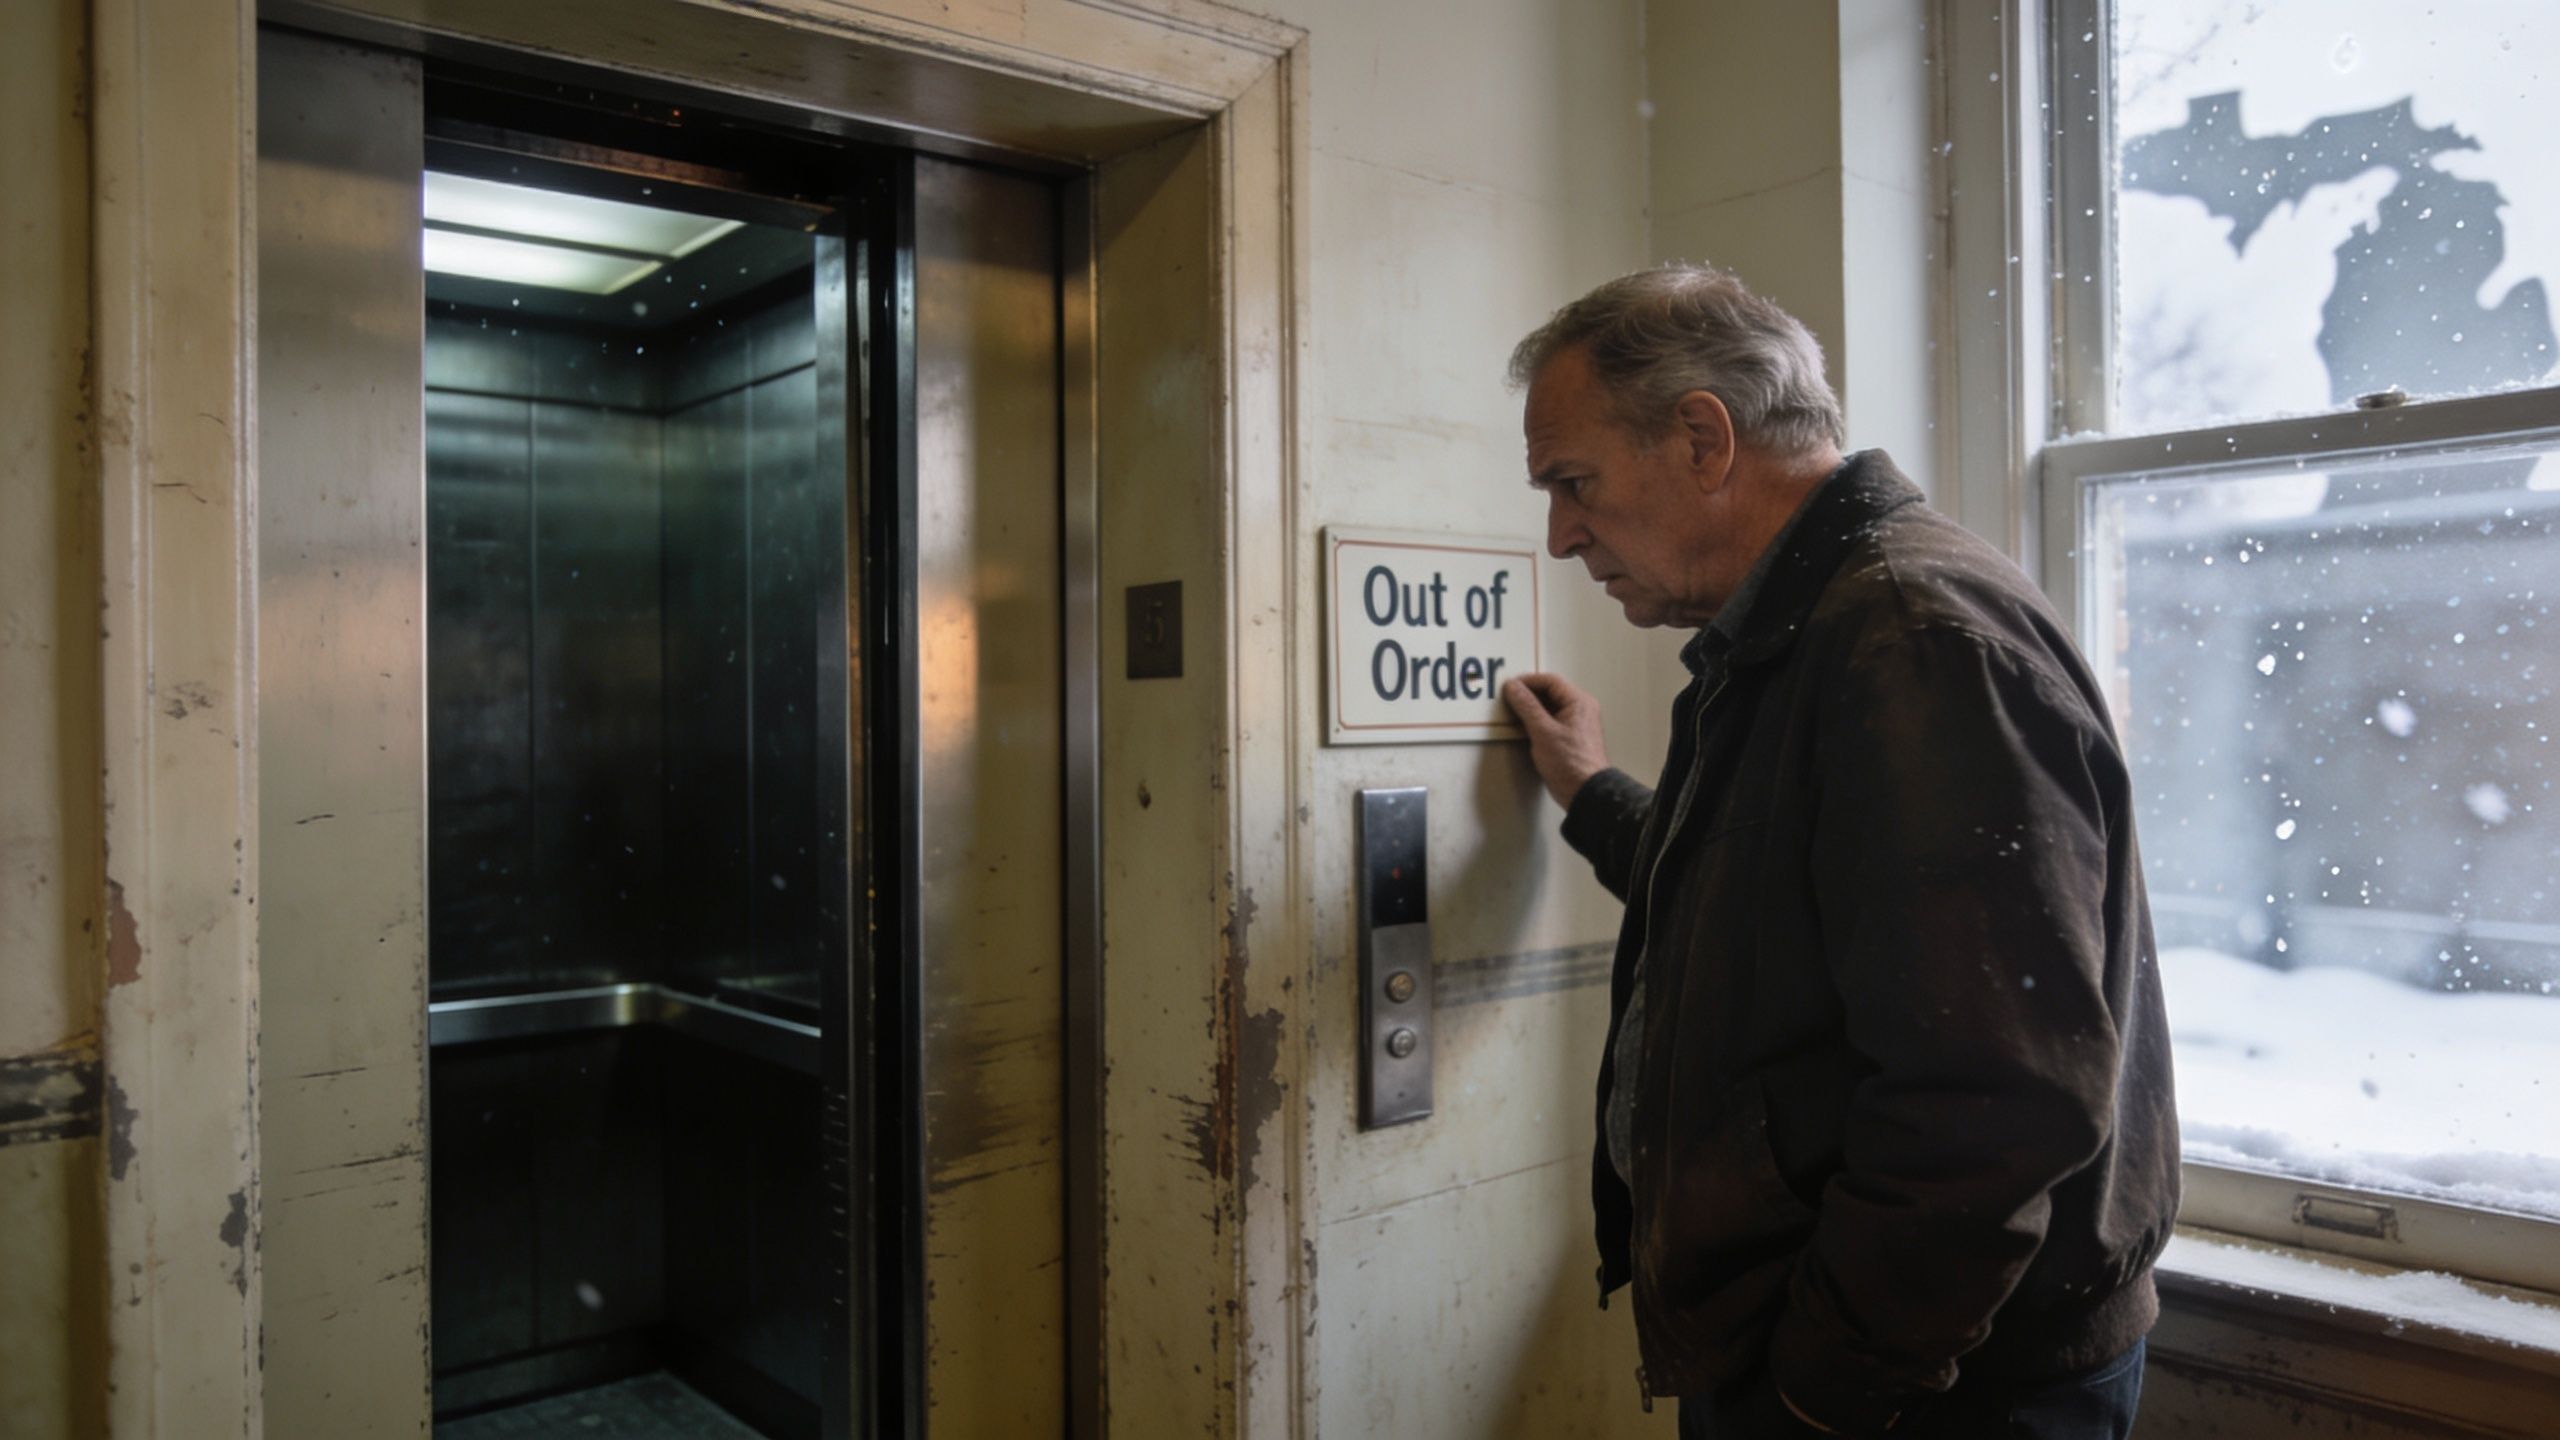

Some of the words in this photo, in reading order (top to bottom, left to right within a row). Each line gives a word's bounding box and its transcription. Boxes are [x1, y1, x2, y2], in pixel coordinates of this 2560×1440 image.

[1363, 565, 1448, 628] Out
[1465, 570, 1509, 629] of
[1371, 639, 1504, 702] Order
